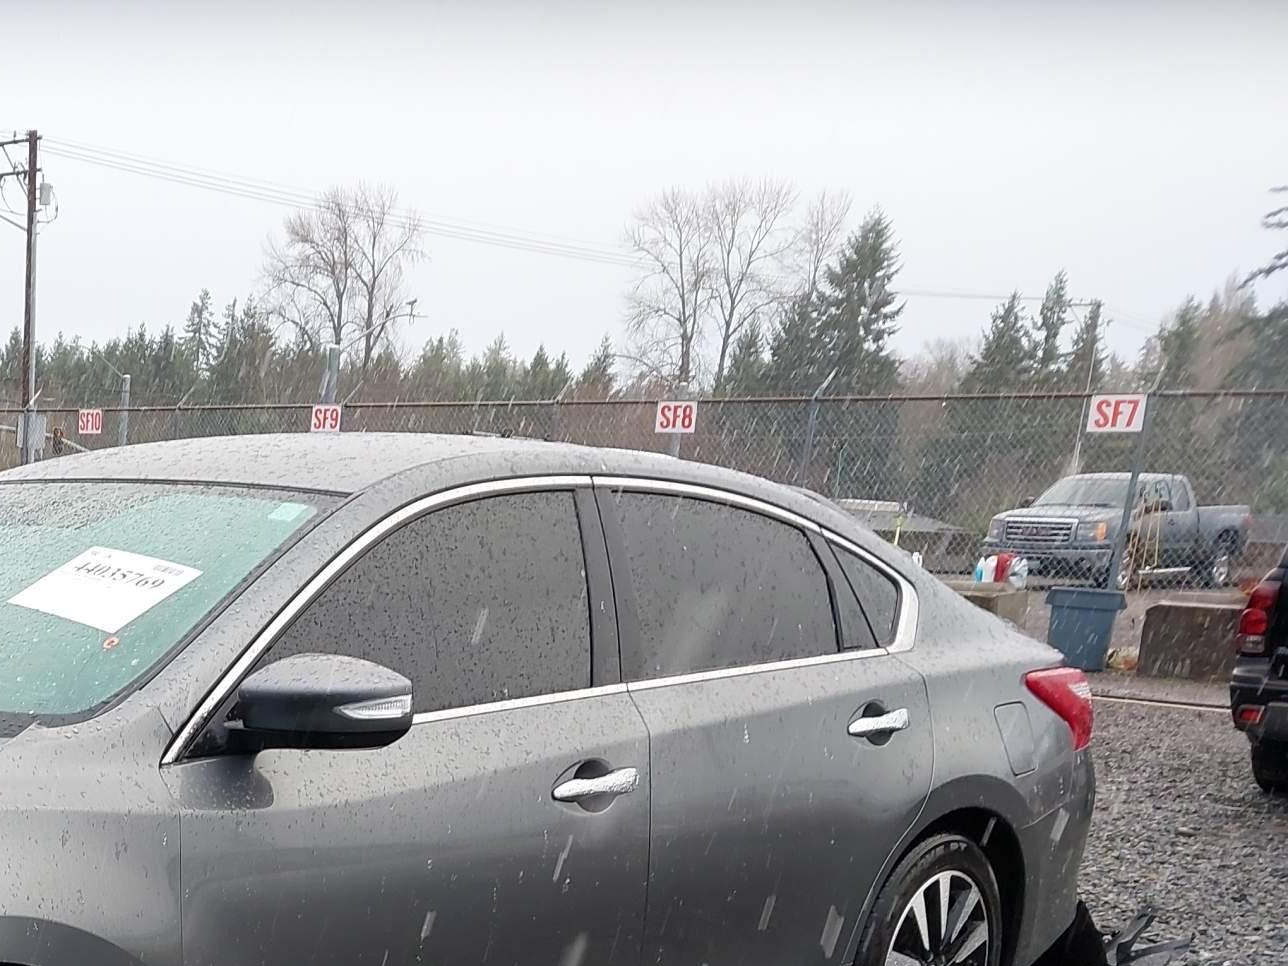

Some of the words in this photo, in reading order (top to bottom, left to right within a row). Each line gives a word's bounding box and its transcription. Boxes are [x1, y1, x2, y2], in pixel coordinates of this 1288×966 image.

[79, 412, 102, 431] SF10
[313, 408, 339, 430] SF9
[660, 404, 693, 430] SF8
[1094, 399, 1141, 428] SF7
[74, 561, 166, 589] 44035769
